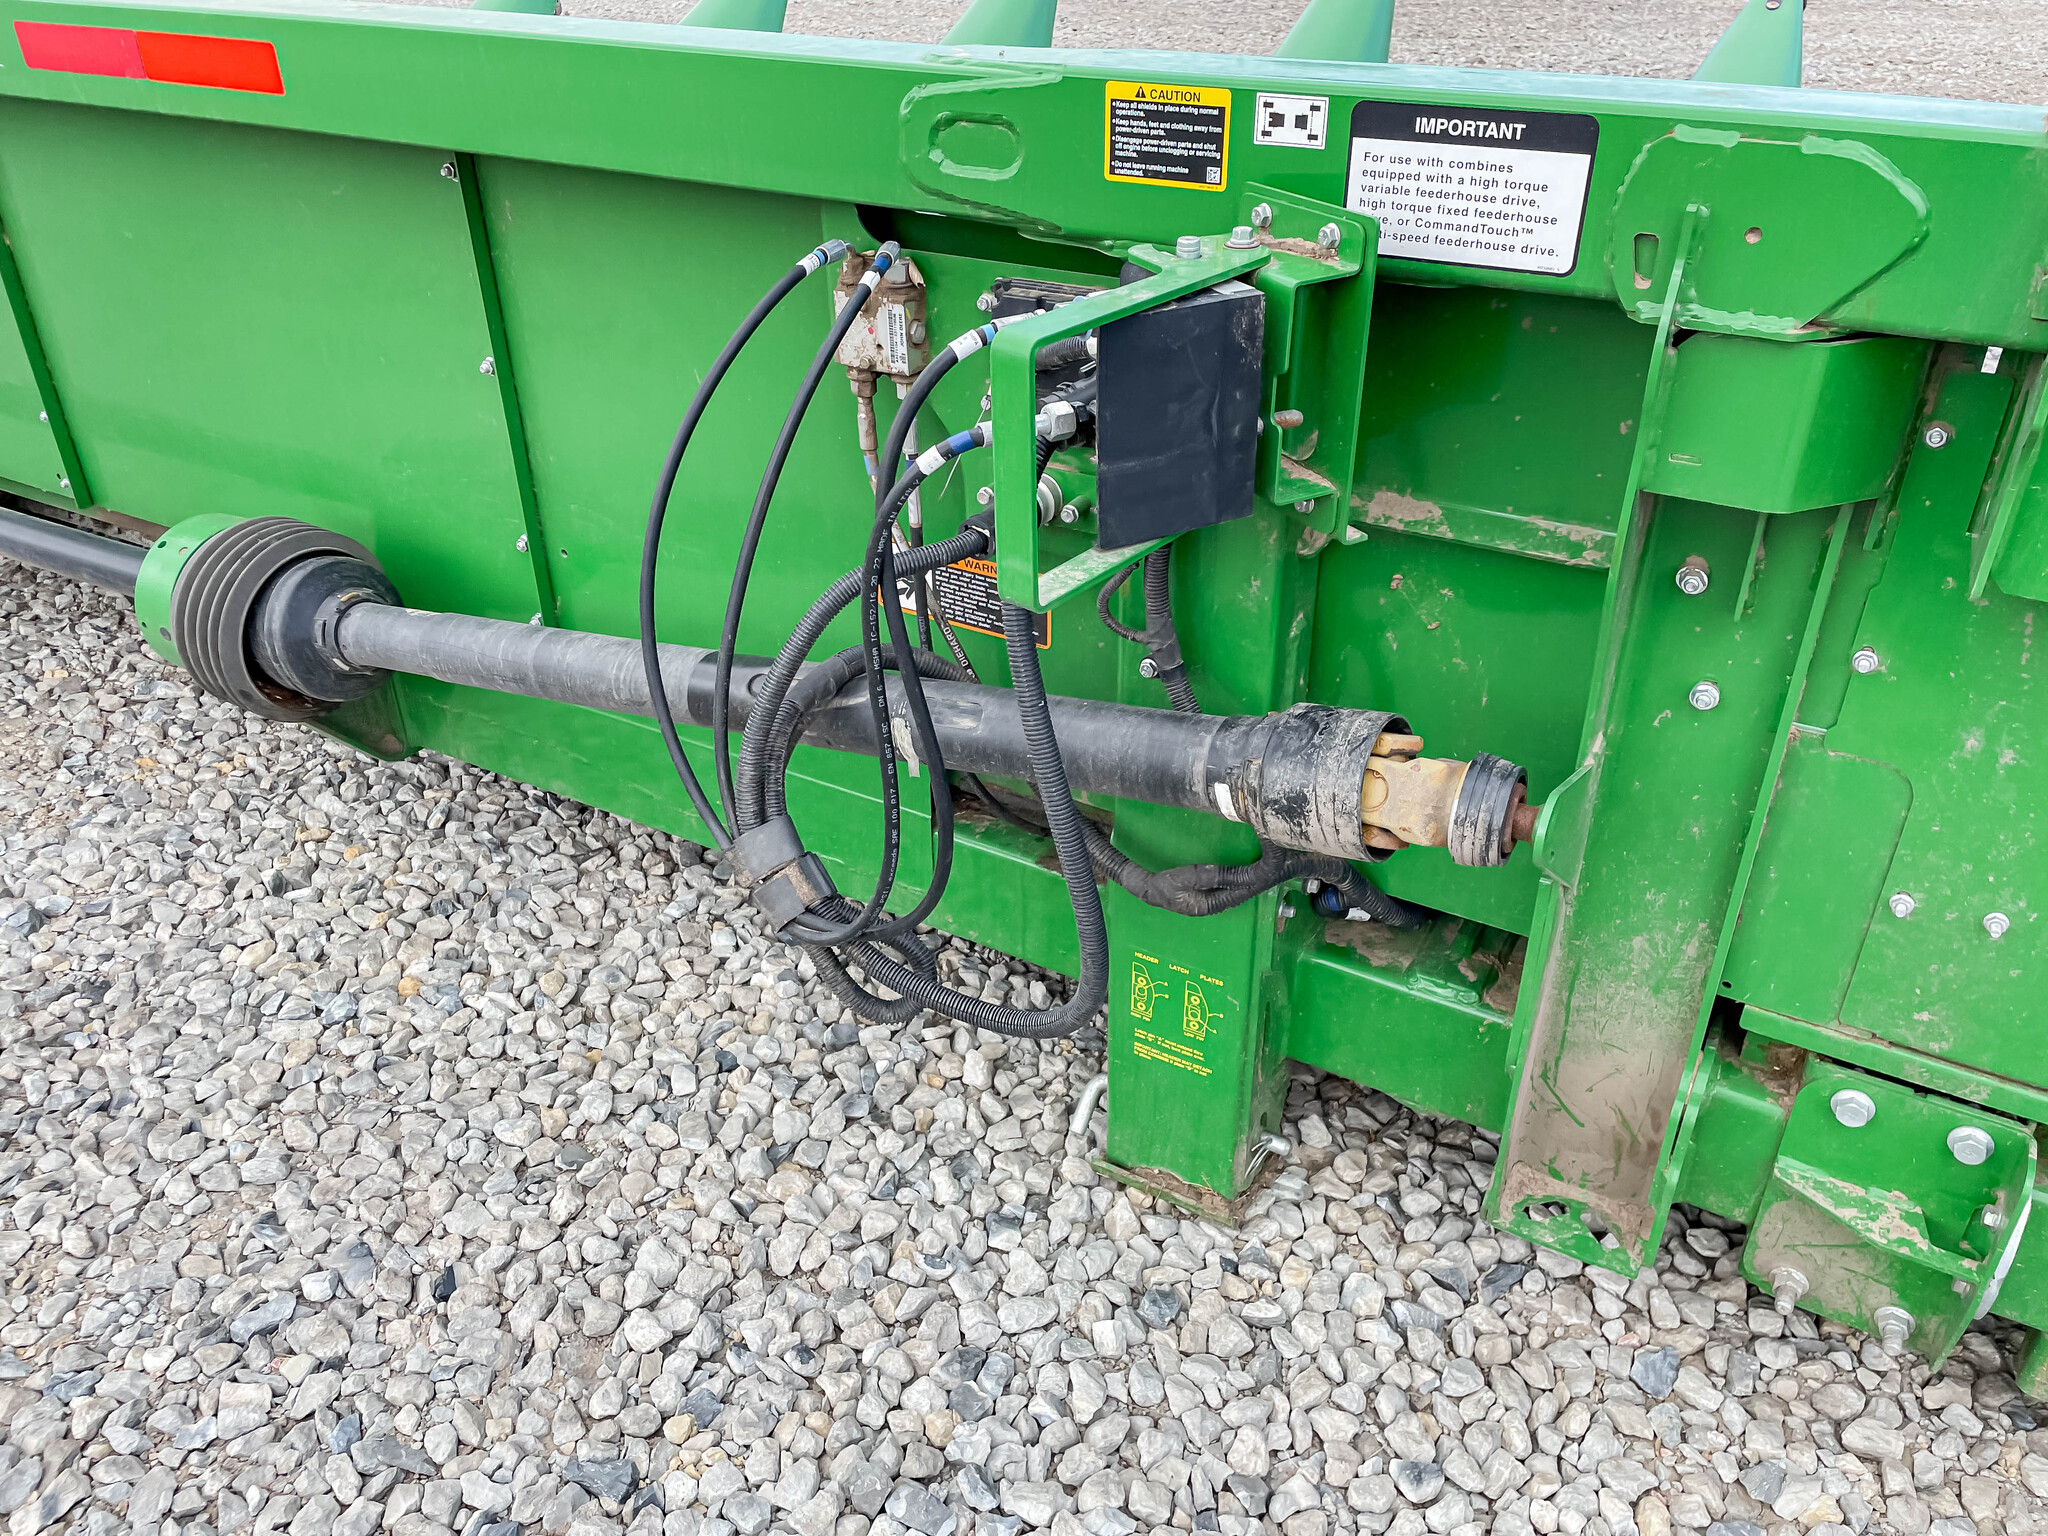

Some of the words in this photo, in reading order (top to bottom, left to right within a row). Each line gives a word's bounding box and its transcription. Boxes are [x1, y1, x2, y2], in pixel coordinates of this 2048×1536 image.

[1150, 89, 1200, 102] CAUTION
[1116, 101, 1130, 109] Keep
[1138, 102, 1157, 110] shields
[1180, 106, 1198, 115] during
[1415, 117, 1526, 140] IMPORTANT
[1364, 151, 1384, 162] For
[1390, 156, 1411, 165] use
[1417, 156, 1443, 167] with
[1449, 160, 1513, 173] combines
[1362, 169, 1420, 182] equipped
[1426, 173, 1452, 184] with
[1458, 177, 1465, 185] a
[1470, 176, 1498, 189] high
[1505, 180, 1548, 193] torque
[1361, 184, 1410, 196] variable
[1416, 187, 1497, 203] feederhouse
[1503, 195, 1540, 209] drive,
[1360, 198, 1386, 210] high
[1391, 201, 1432, 214] torque
[1437, 204, 1469, 217] fixed
[1474, 207, 1558, 225] feederhouse
[1397, 218, 1410, 226] or
[1379, 230, 1430, 244] ti-speed
[1435, 235, 1516, 252] feederhouse
[1521, 244, 1559, 257] drive.
[872, 647, 880, 670] MSHA
[943, 627, 969, 667] DIEHARD
[878, 695, 885, 708] DN
[888, 763, 894, 775] EN
[888, 848, 897, 881] exceeds
[1134, 952, 1159, 964] HEADER
[1169, 963, 1189, 975] LATCH
[1199, 974, 1224, 986] PLATES
